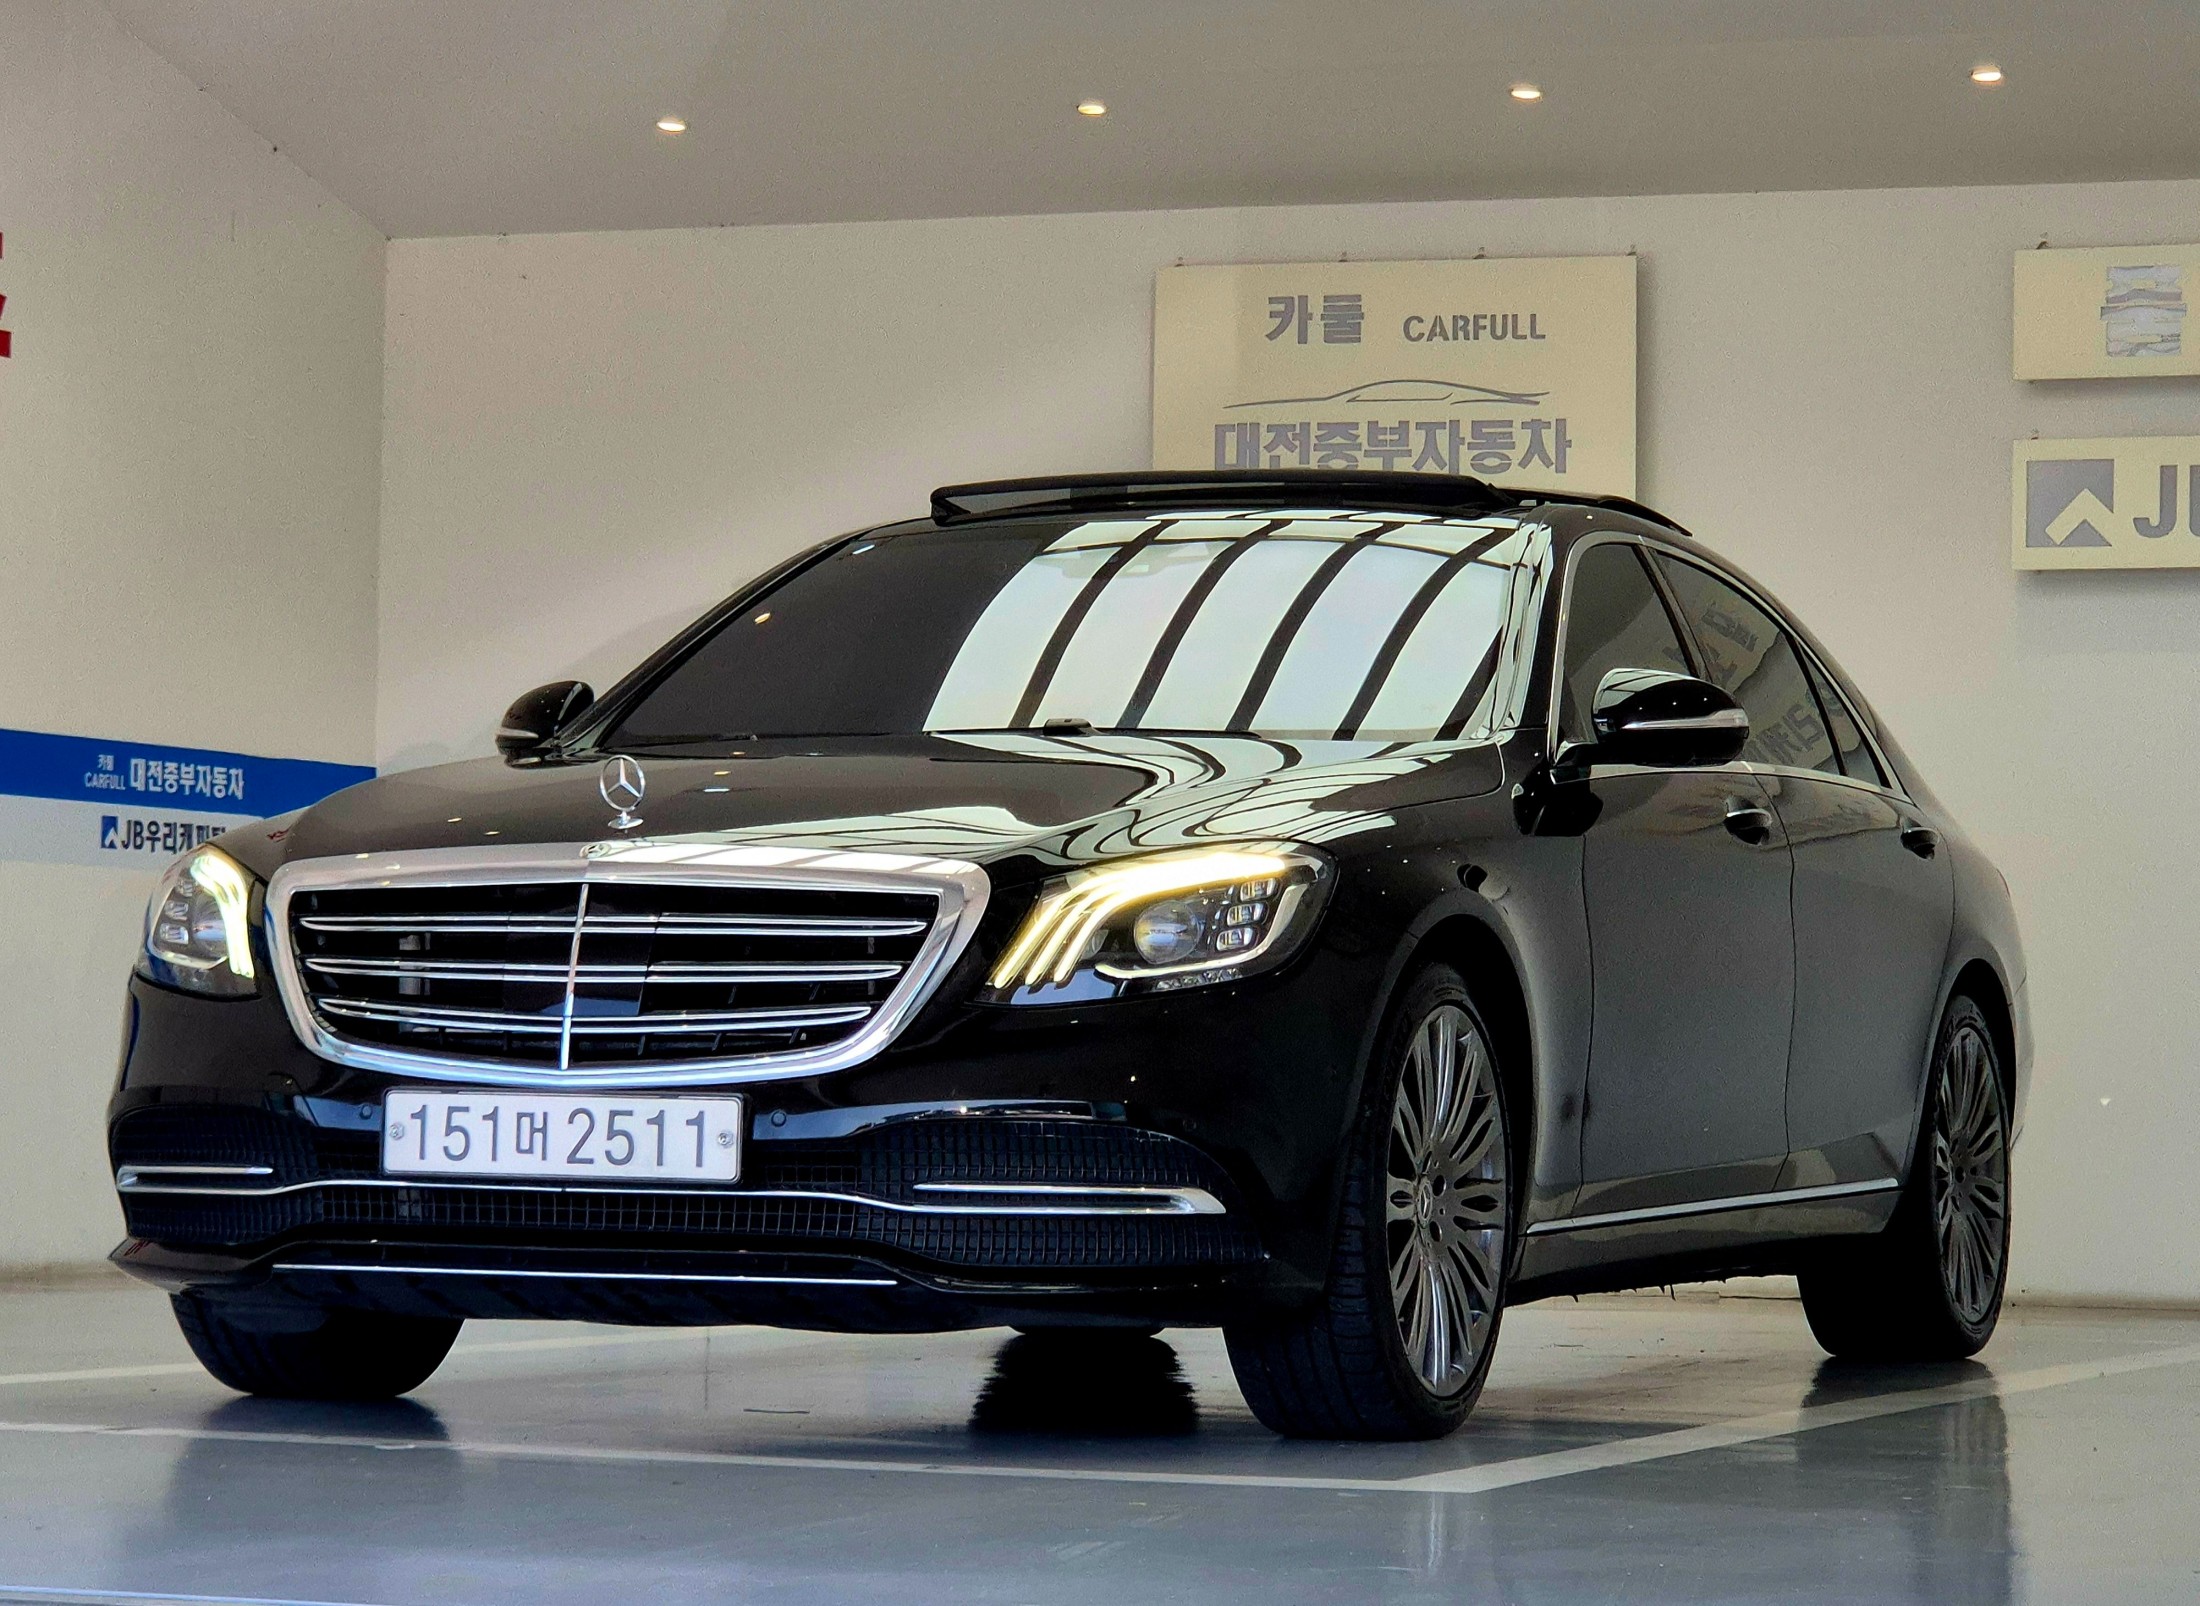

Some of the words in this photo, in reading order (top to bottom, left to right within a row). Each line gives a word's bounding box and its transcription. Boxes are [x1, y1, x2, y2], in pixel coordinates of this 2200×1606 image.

[1402, 312, 1547, 342] CARFULL
[1214, 418, 1572, 475] 대전중부자동차
[84, 771, 126, 791] CARFULL
[130, 757, 245, 800] 대전중부자동차
[121, 818, 226, 856] JB우리캐피
